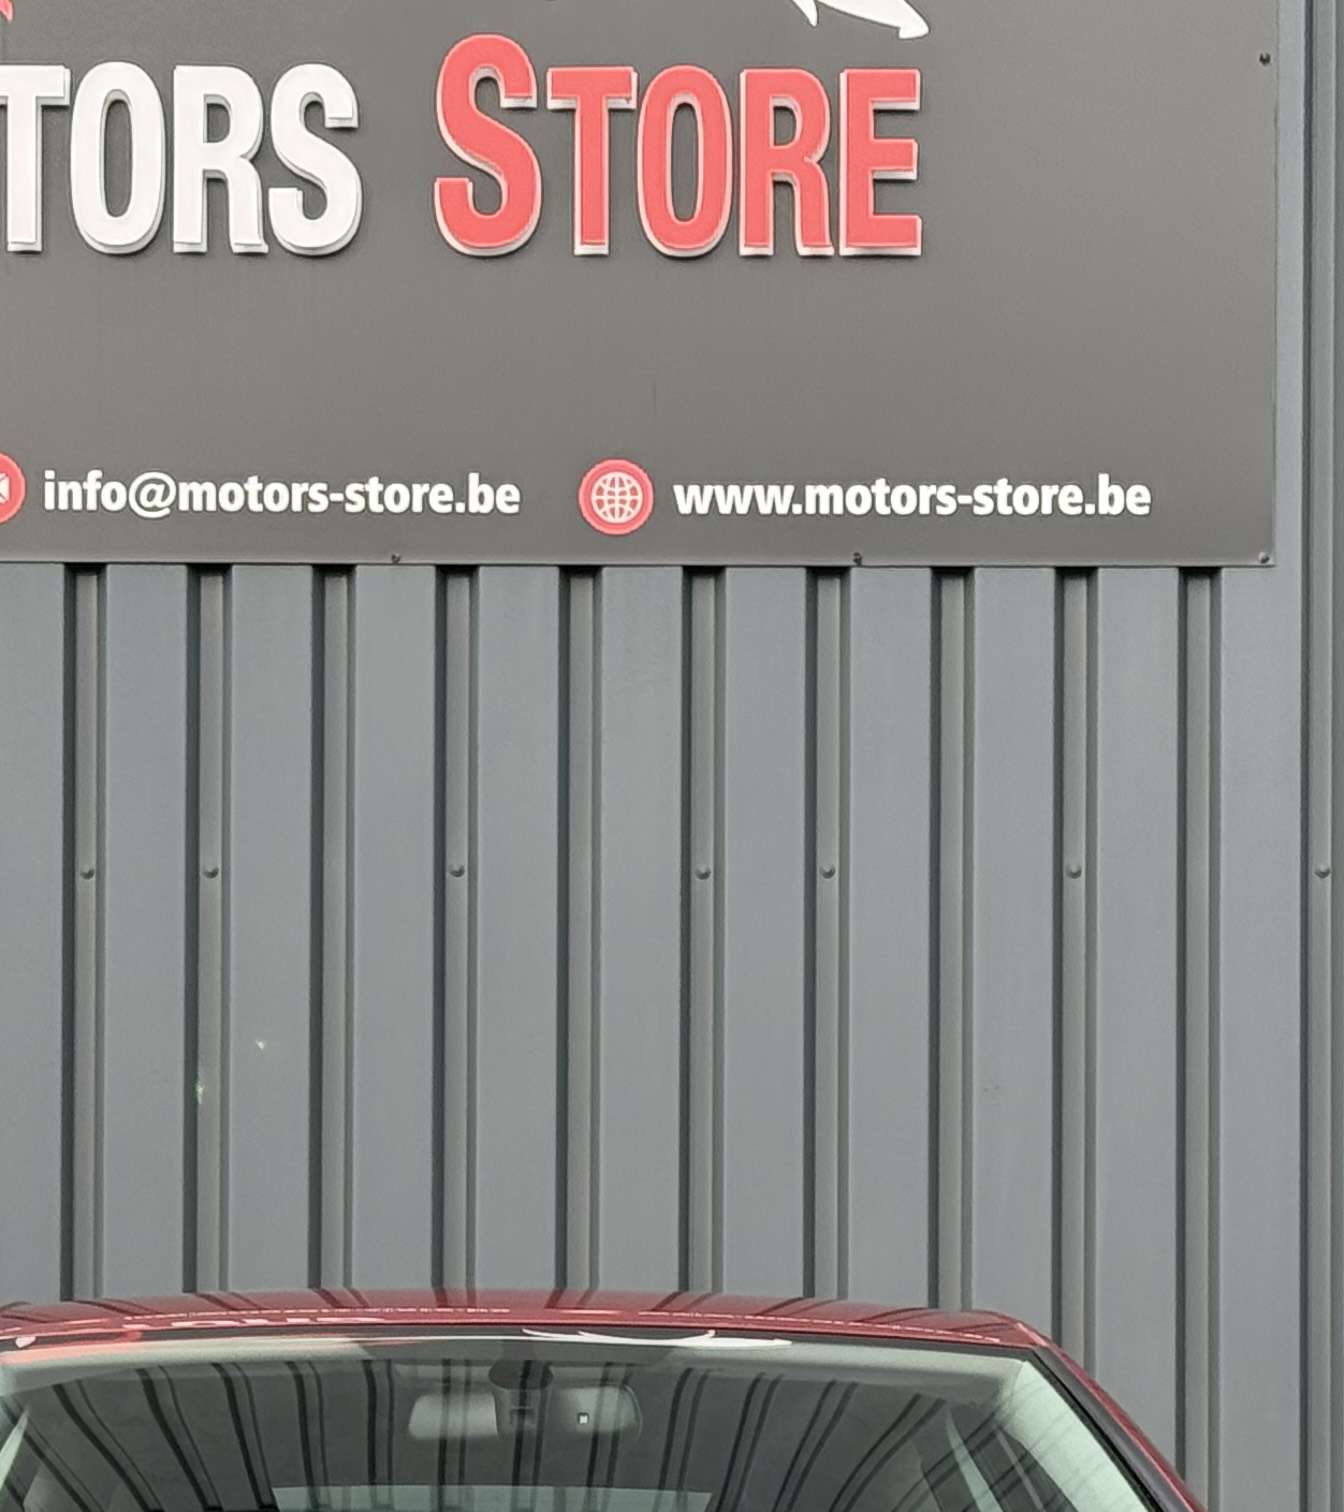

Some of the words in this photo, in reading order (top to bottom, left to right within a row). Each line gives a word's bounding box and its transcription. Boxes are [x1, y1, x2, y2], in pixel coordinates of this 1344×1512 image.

[433, 33, 923, 257] STORE
[44, 469, 521, 518] info@motors-store.be
[673, 473, 1151, 515] www.motors-store.be
